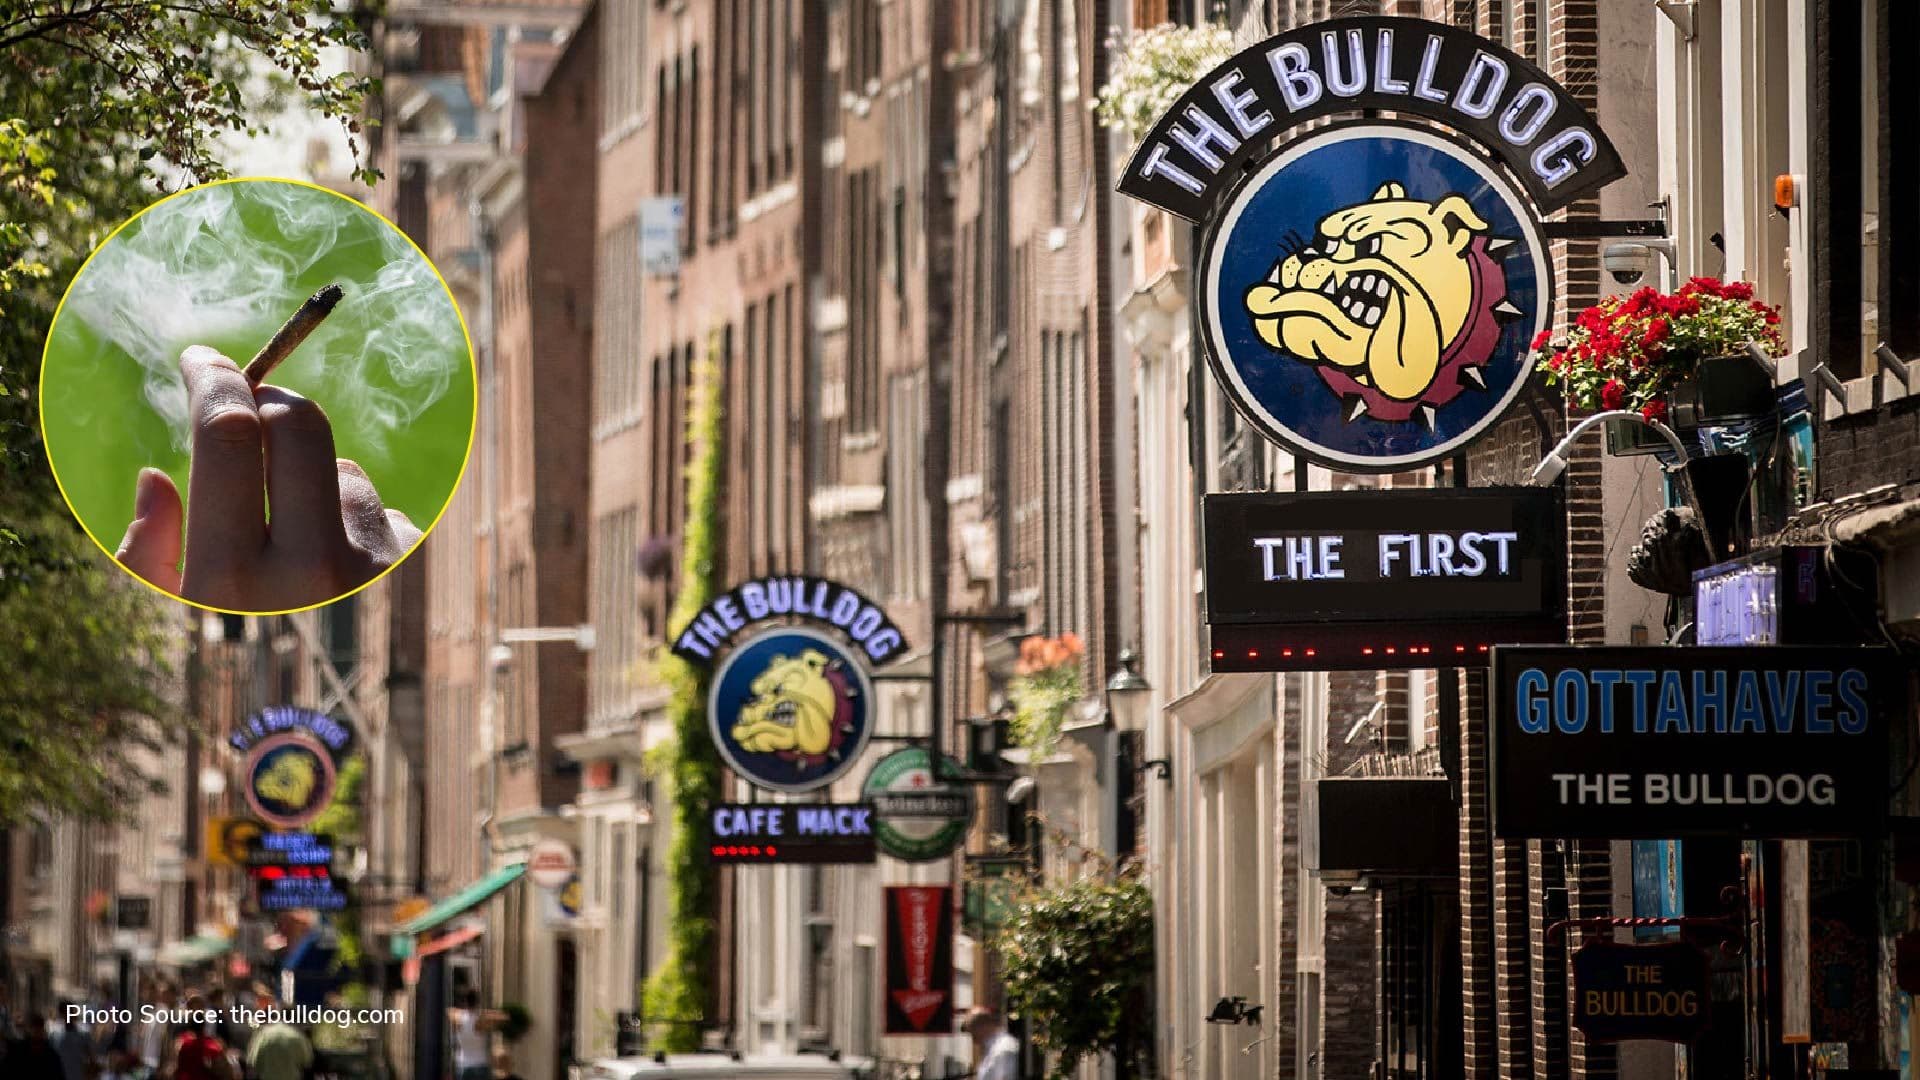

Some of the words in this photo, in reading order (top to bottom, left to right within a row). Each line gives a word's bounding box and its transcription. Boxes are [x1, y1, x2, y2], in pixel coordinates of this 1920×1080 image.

[1140, 68, 1274, 194] THE
[1266, 28, 1598, 190] BULLDOG
[1253, 535, 1346, 581] THE
[1378, 531, 1518, 578] FIRST
[679, 594, 746, 659] THE
[741, 577, 902, 661] BULLDOG
[1516, 668, 1869, 735] GOTTAHAVES
[1552, 773, 1633, 805] THE
[1644, 773, 1836, 806] BULLDOG
[713, 808, 784, 836] CAFE
[1624, 965, 1664, 985] THE
[1585, 990, 1698, 1017] BULLDOG
